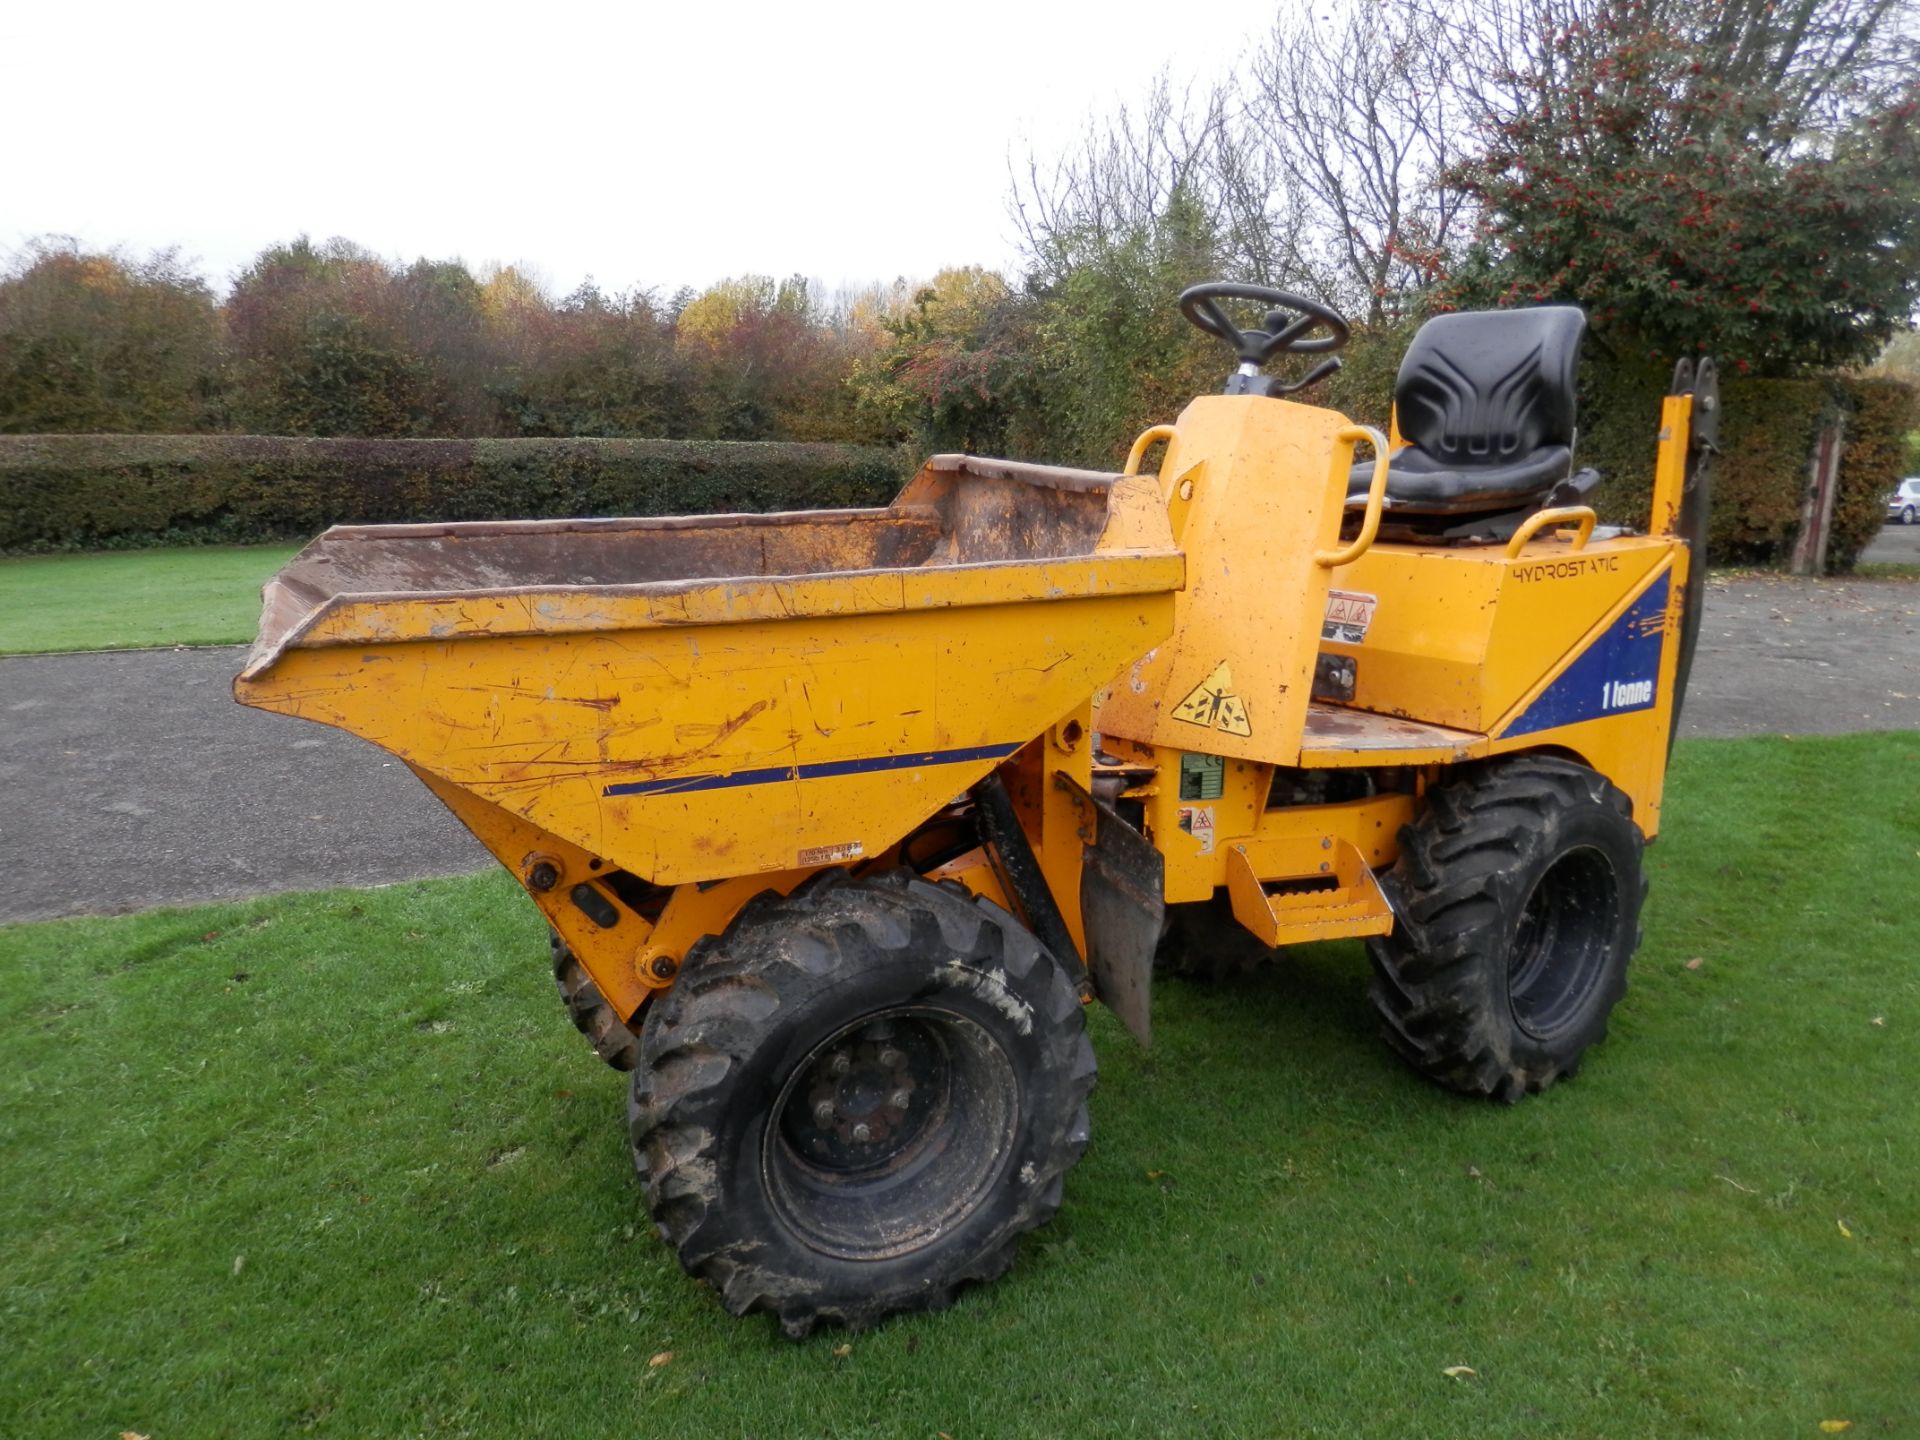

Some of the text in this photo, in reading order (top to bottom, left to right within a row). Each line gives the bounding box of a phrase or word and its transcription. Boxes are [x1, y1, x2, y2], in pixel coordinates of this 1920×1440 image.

[1512, 556, 1619, 584] HYDROSTATIC
[1602, 680, 1652, 710] 1 tonne
